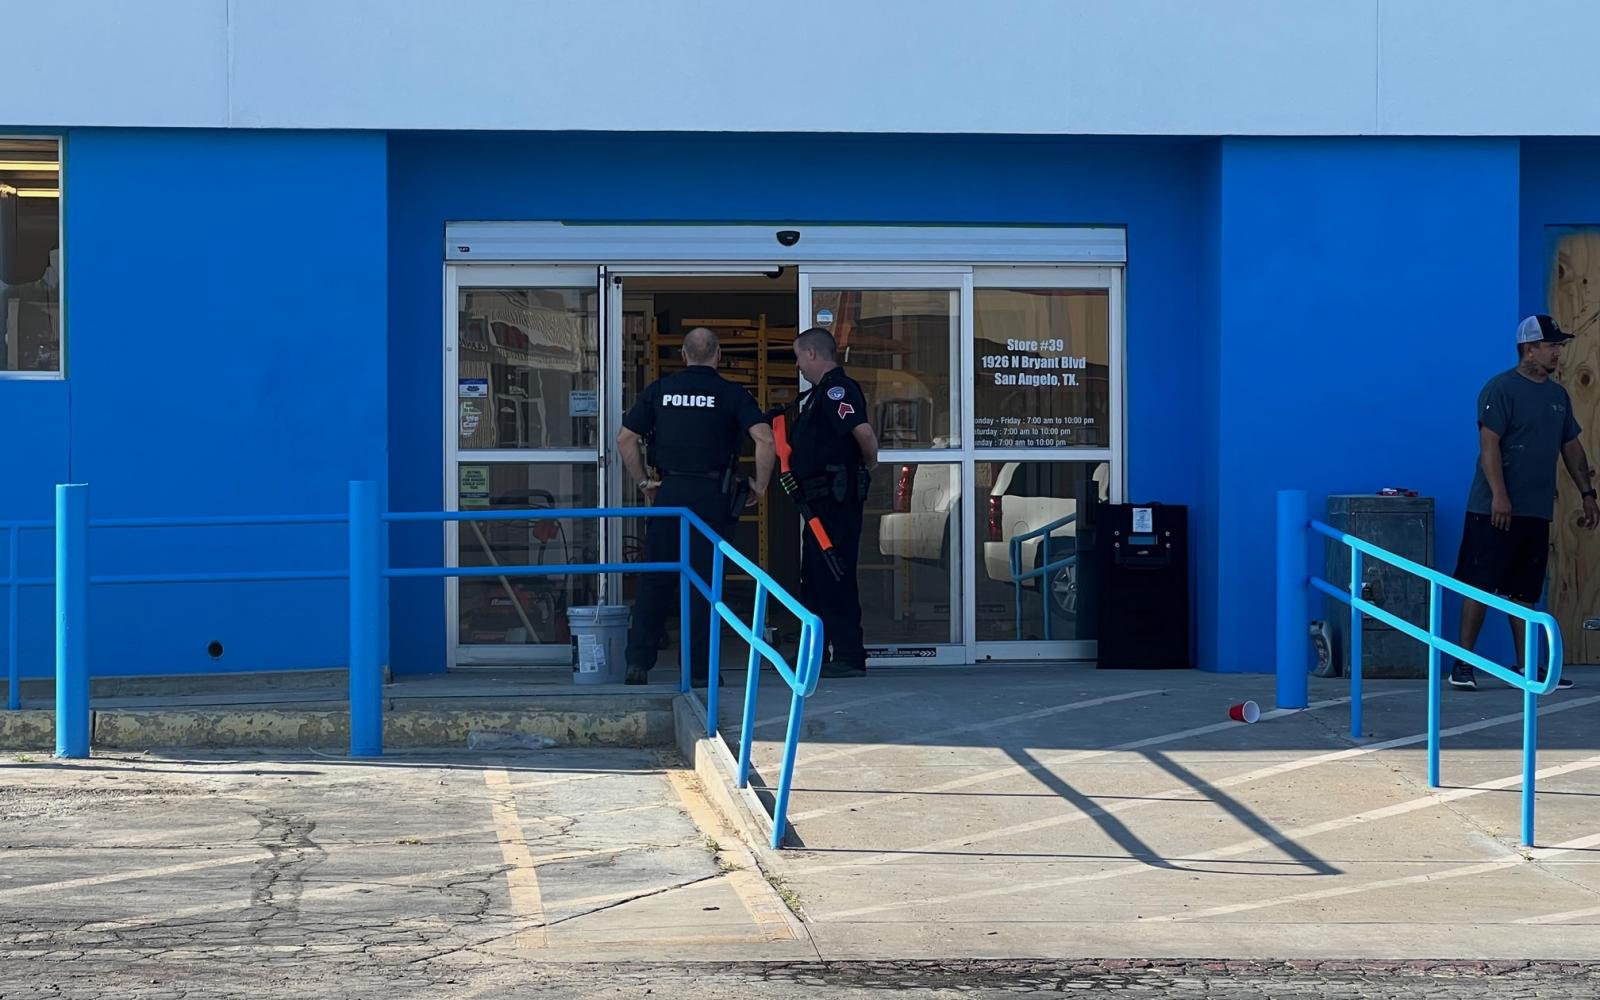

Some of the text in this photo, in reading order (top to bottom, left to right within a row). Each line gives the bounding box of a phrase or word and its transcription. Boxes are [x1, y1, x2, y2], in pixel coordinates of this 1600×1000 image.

[1007, 338, 1064, 351] Store #39
[982, 356, 1086, 369] 1926 N Bryant Blvd
[994, 373, 1079, 386] San Angelo, TX.
[662, 394, 715, 408] POLICE
[974, 417, 994, 425] onday
[1001, 416, 1021, 425] Friday
